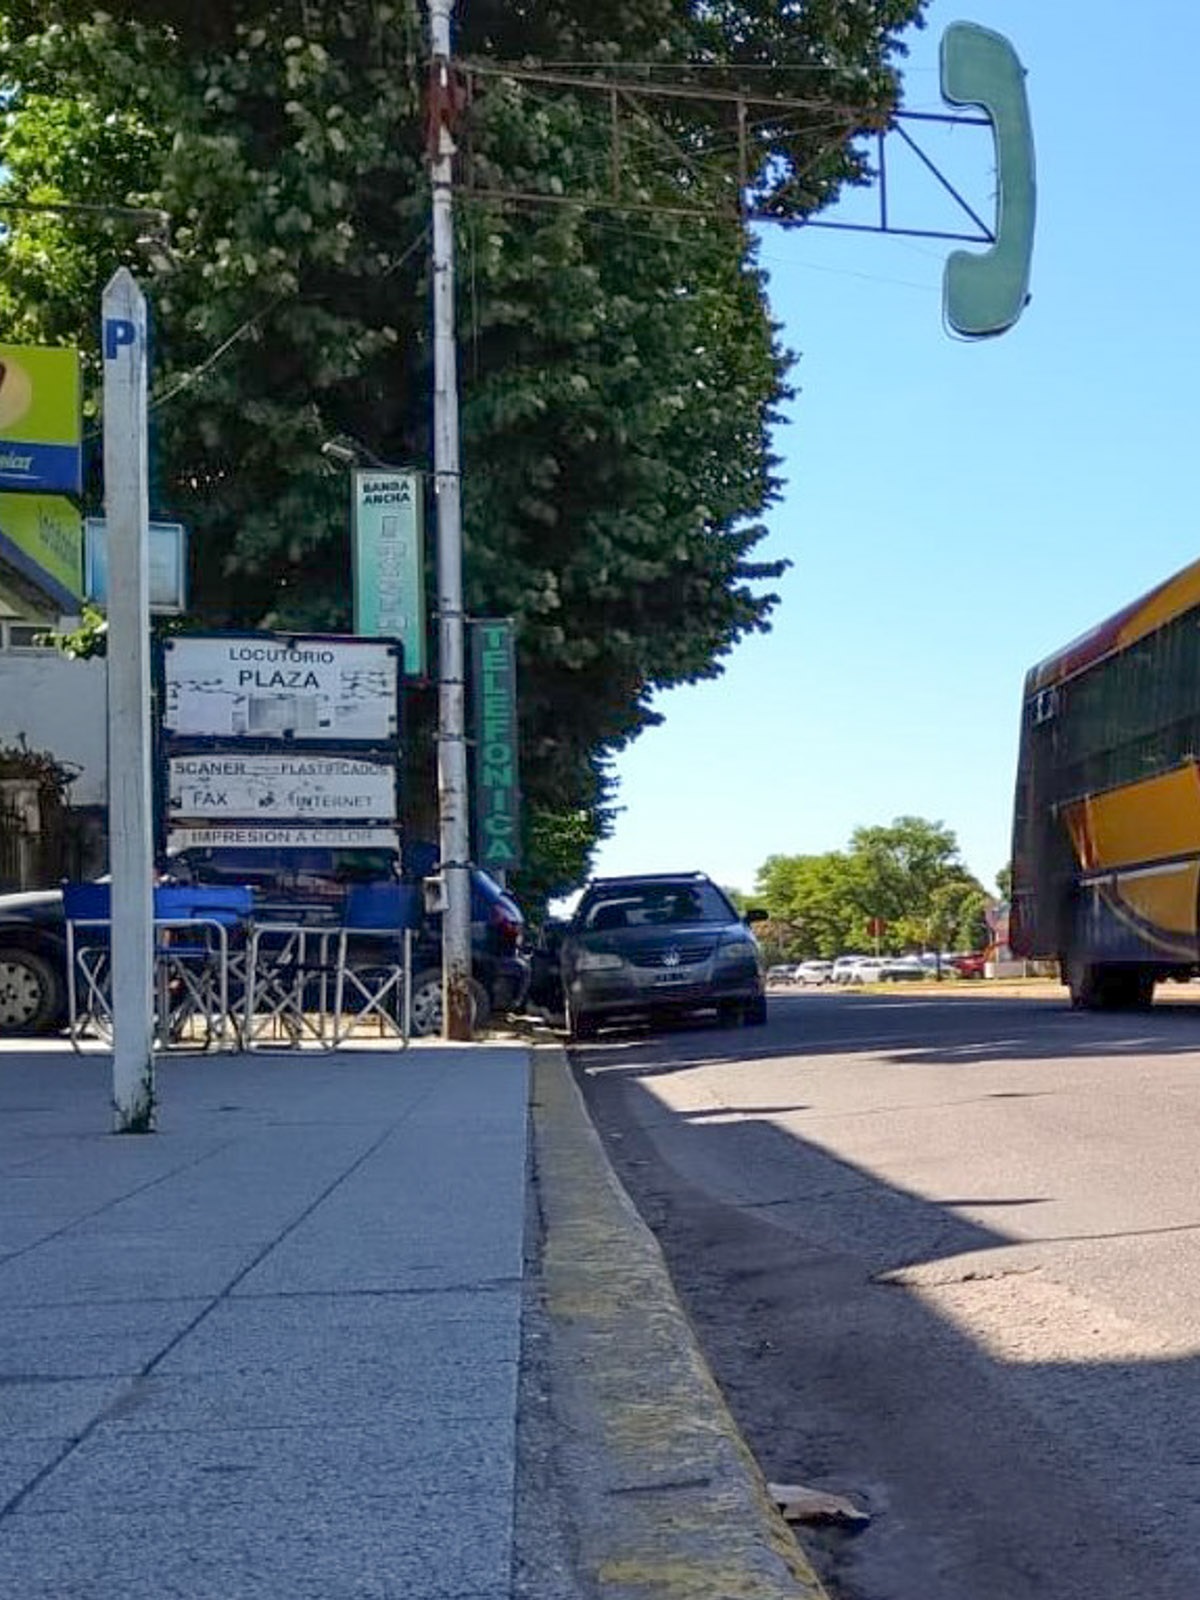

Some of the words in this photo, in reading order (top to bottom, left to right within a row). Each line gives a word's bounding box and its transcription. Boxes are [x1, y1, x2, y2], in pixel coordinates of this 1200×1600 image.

[106, 319, 135, 360] P
[363, 492, 410, 505] ANCHA
[229, 647, 334, 664] LOCUTORIO
[238, 670, 319, 689] PLAZA
[175, 761, 245, 775] SCANER
[193, 791, 228, 806] FAX
[191, 830, 290, 843] IMPRESION
